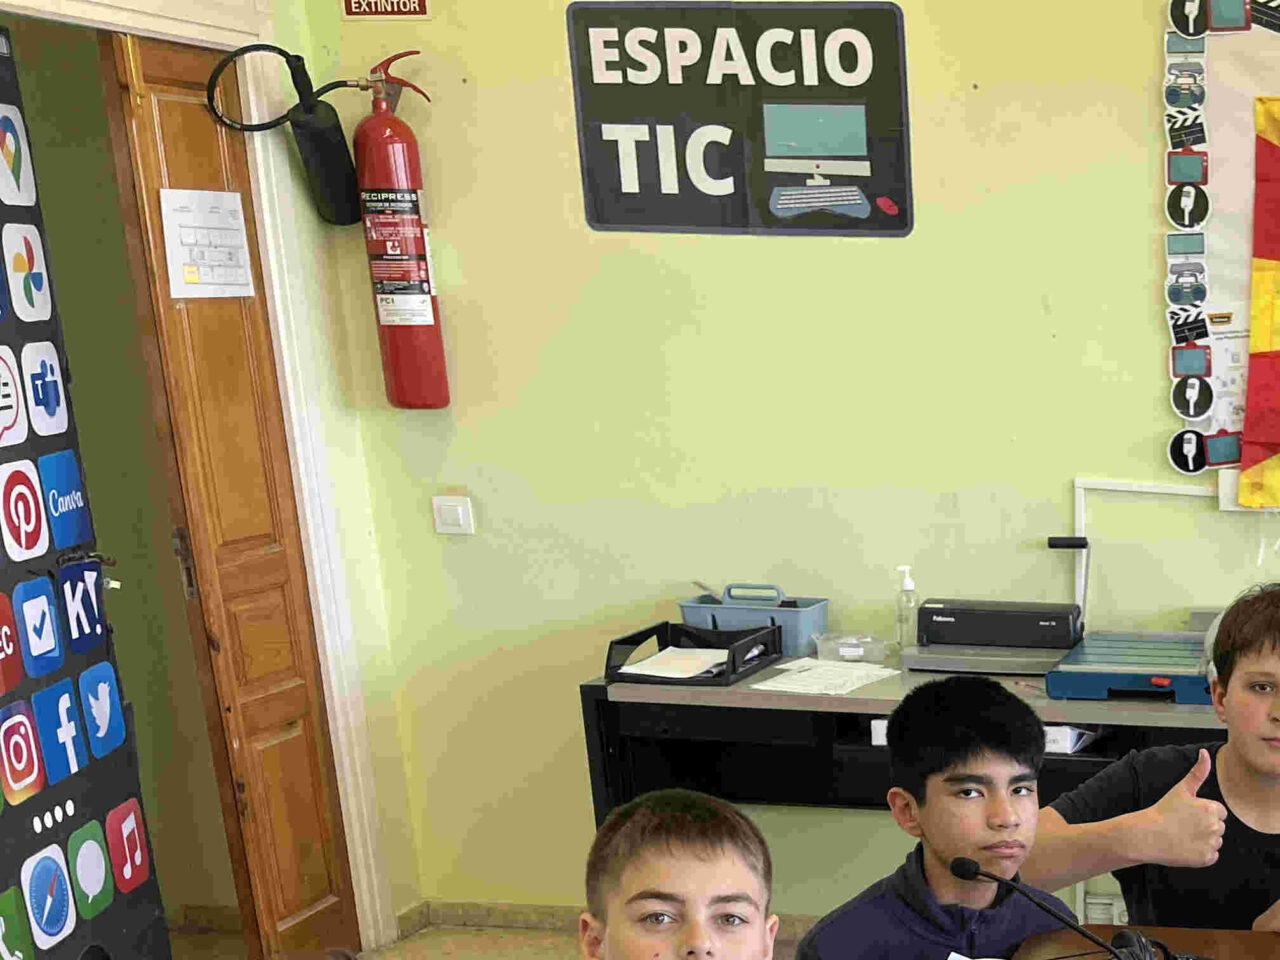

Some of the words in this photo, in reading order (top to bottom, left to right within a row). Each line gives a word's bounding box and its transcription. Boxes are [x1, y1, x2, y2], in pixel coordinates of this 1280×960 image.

[351, 0, 419, 12] EXTINTOR
[588, 27, 873, 87] ESPACIO
[601, 123, 735, 196] TIC
[50, 489, 84, 517] Canva
[62, 570, 102, 640] K!
